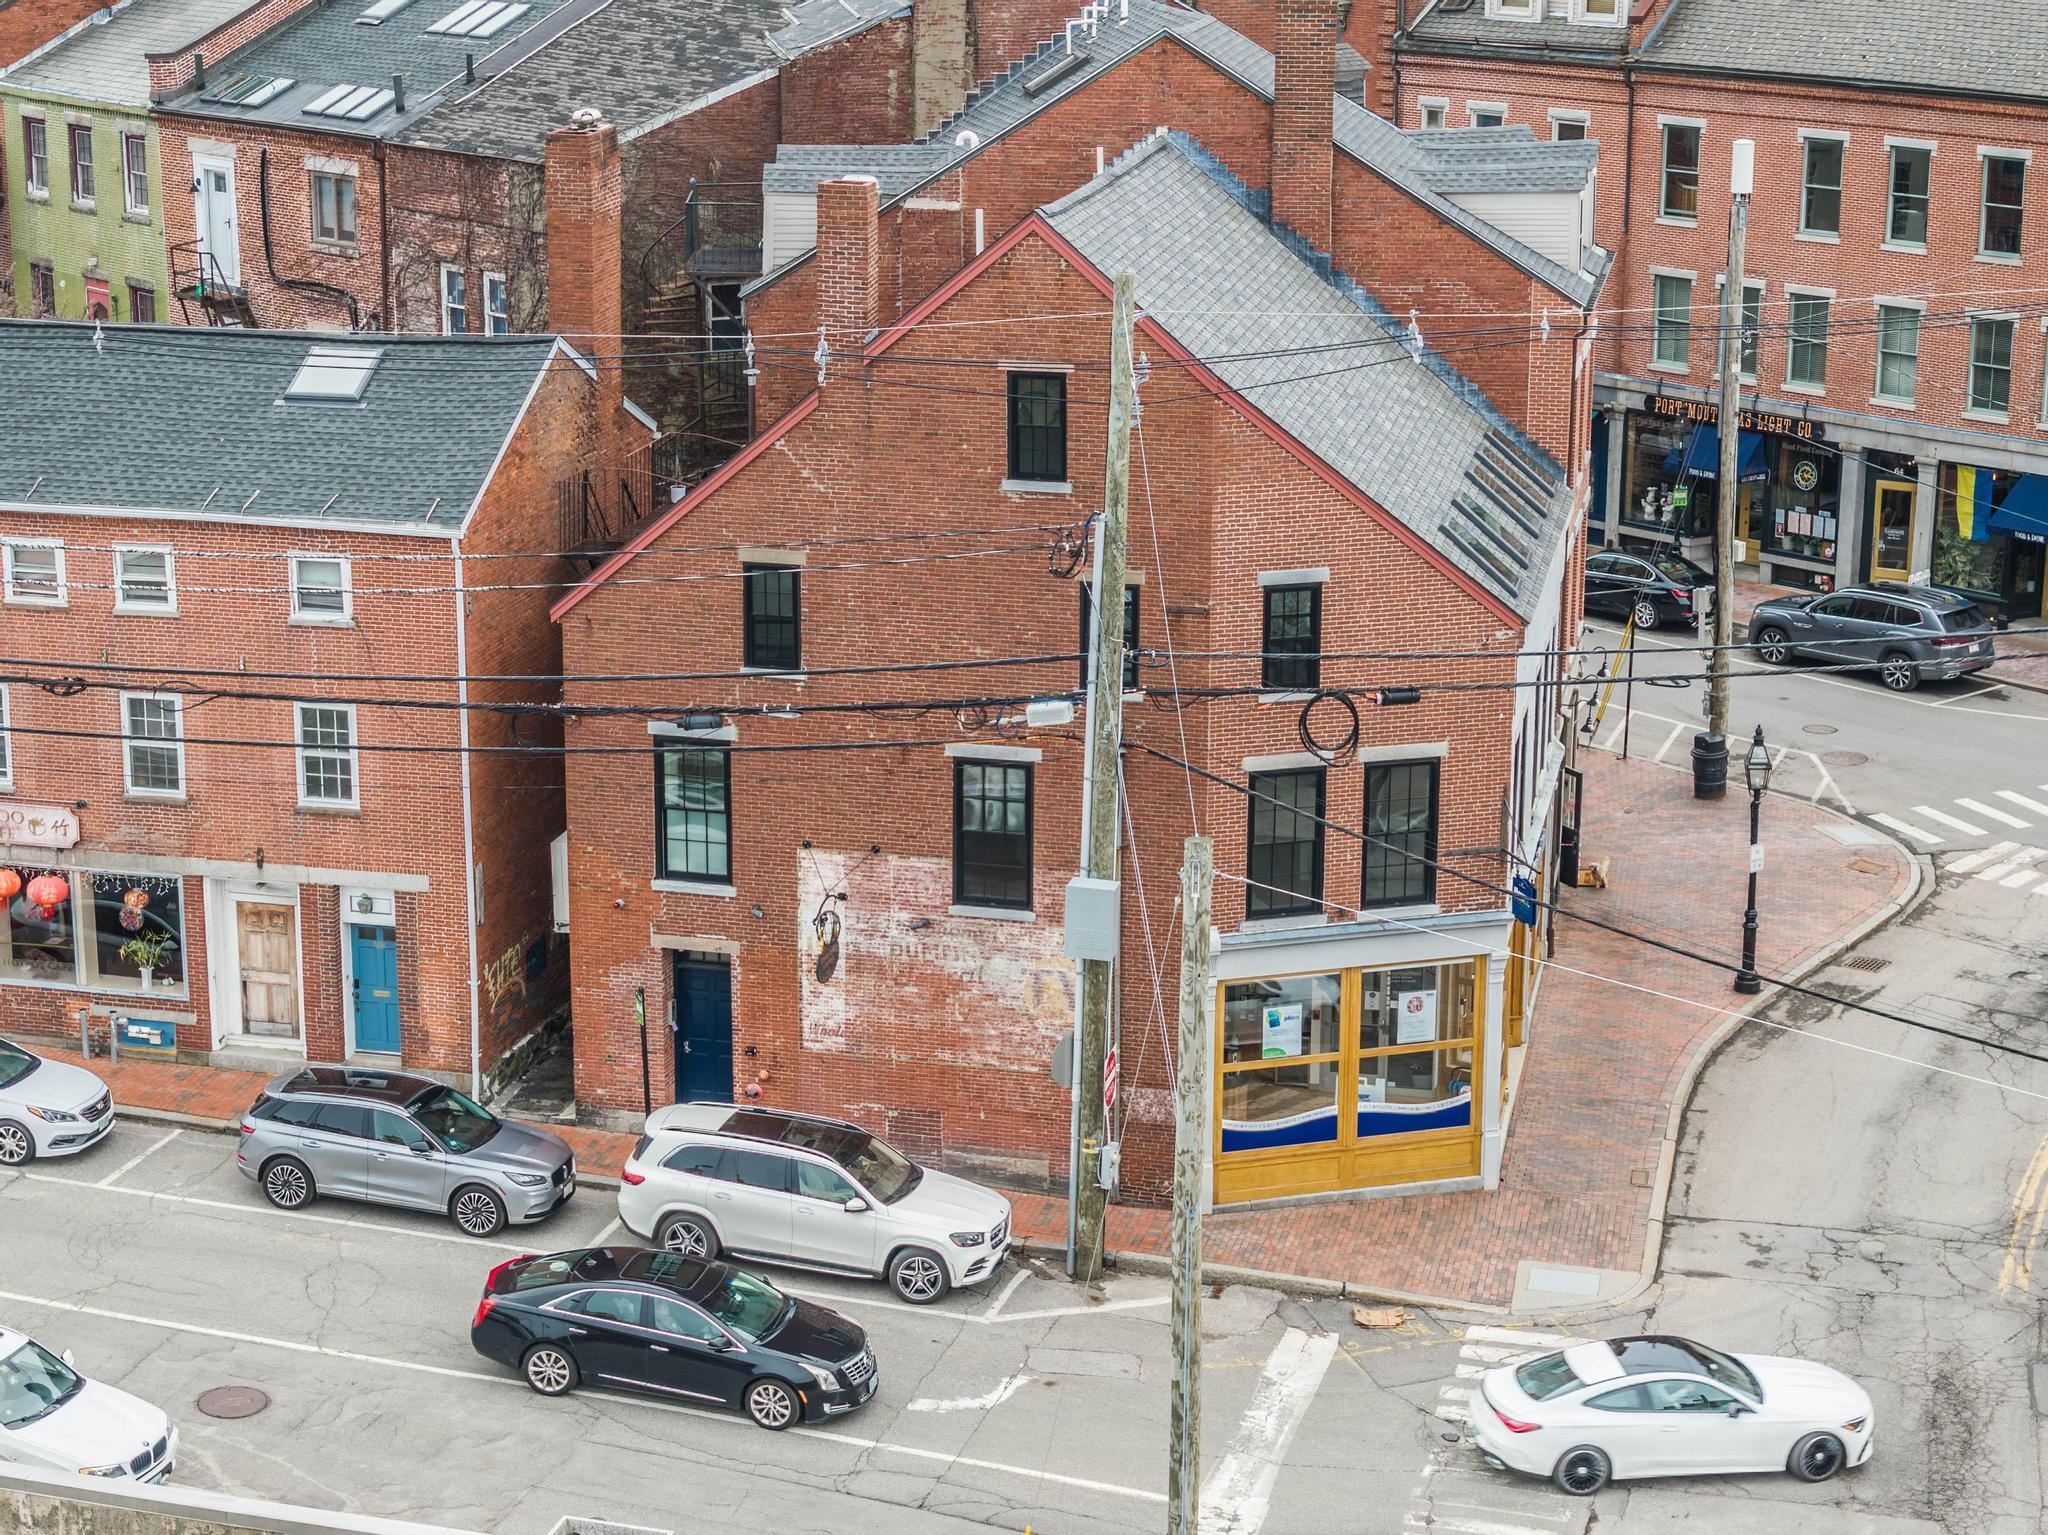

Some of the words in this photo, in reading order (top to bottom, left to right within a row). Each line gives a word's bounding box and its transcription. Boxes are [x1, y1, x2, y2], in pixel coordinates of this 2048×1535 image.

[1654, 397, 1718, 423] PORTMOUT
[1757, 414, 1792, 433] LIGHT
[1895, 467, 1904, 476] 64
[51, 818, 70, 836] 竹
